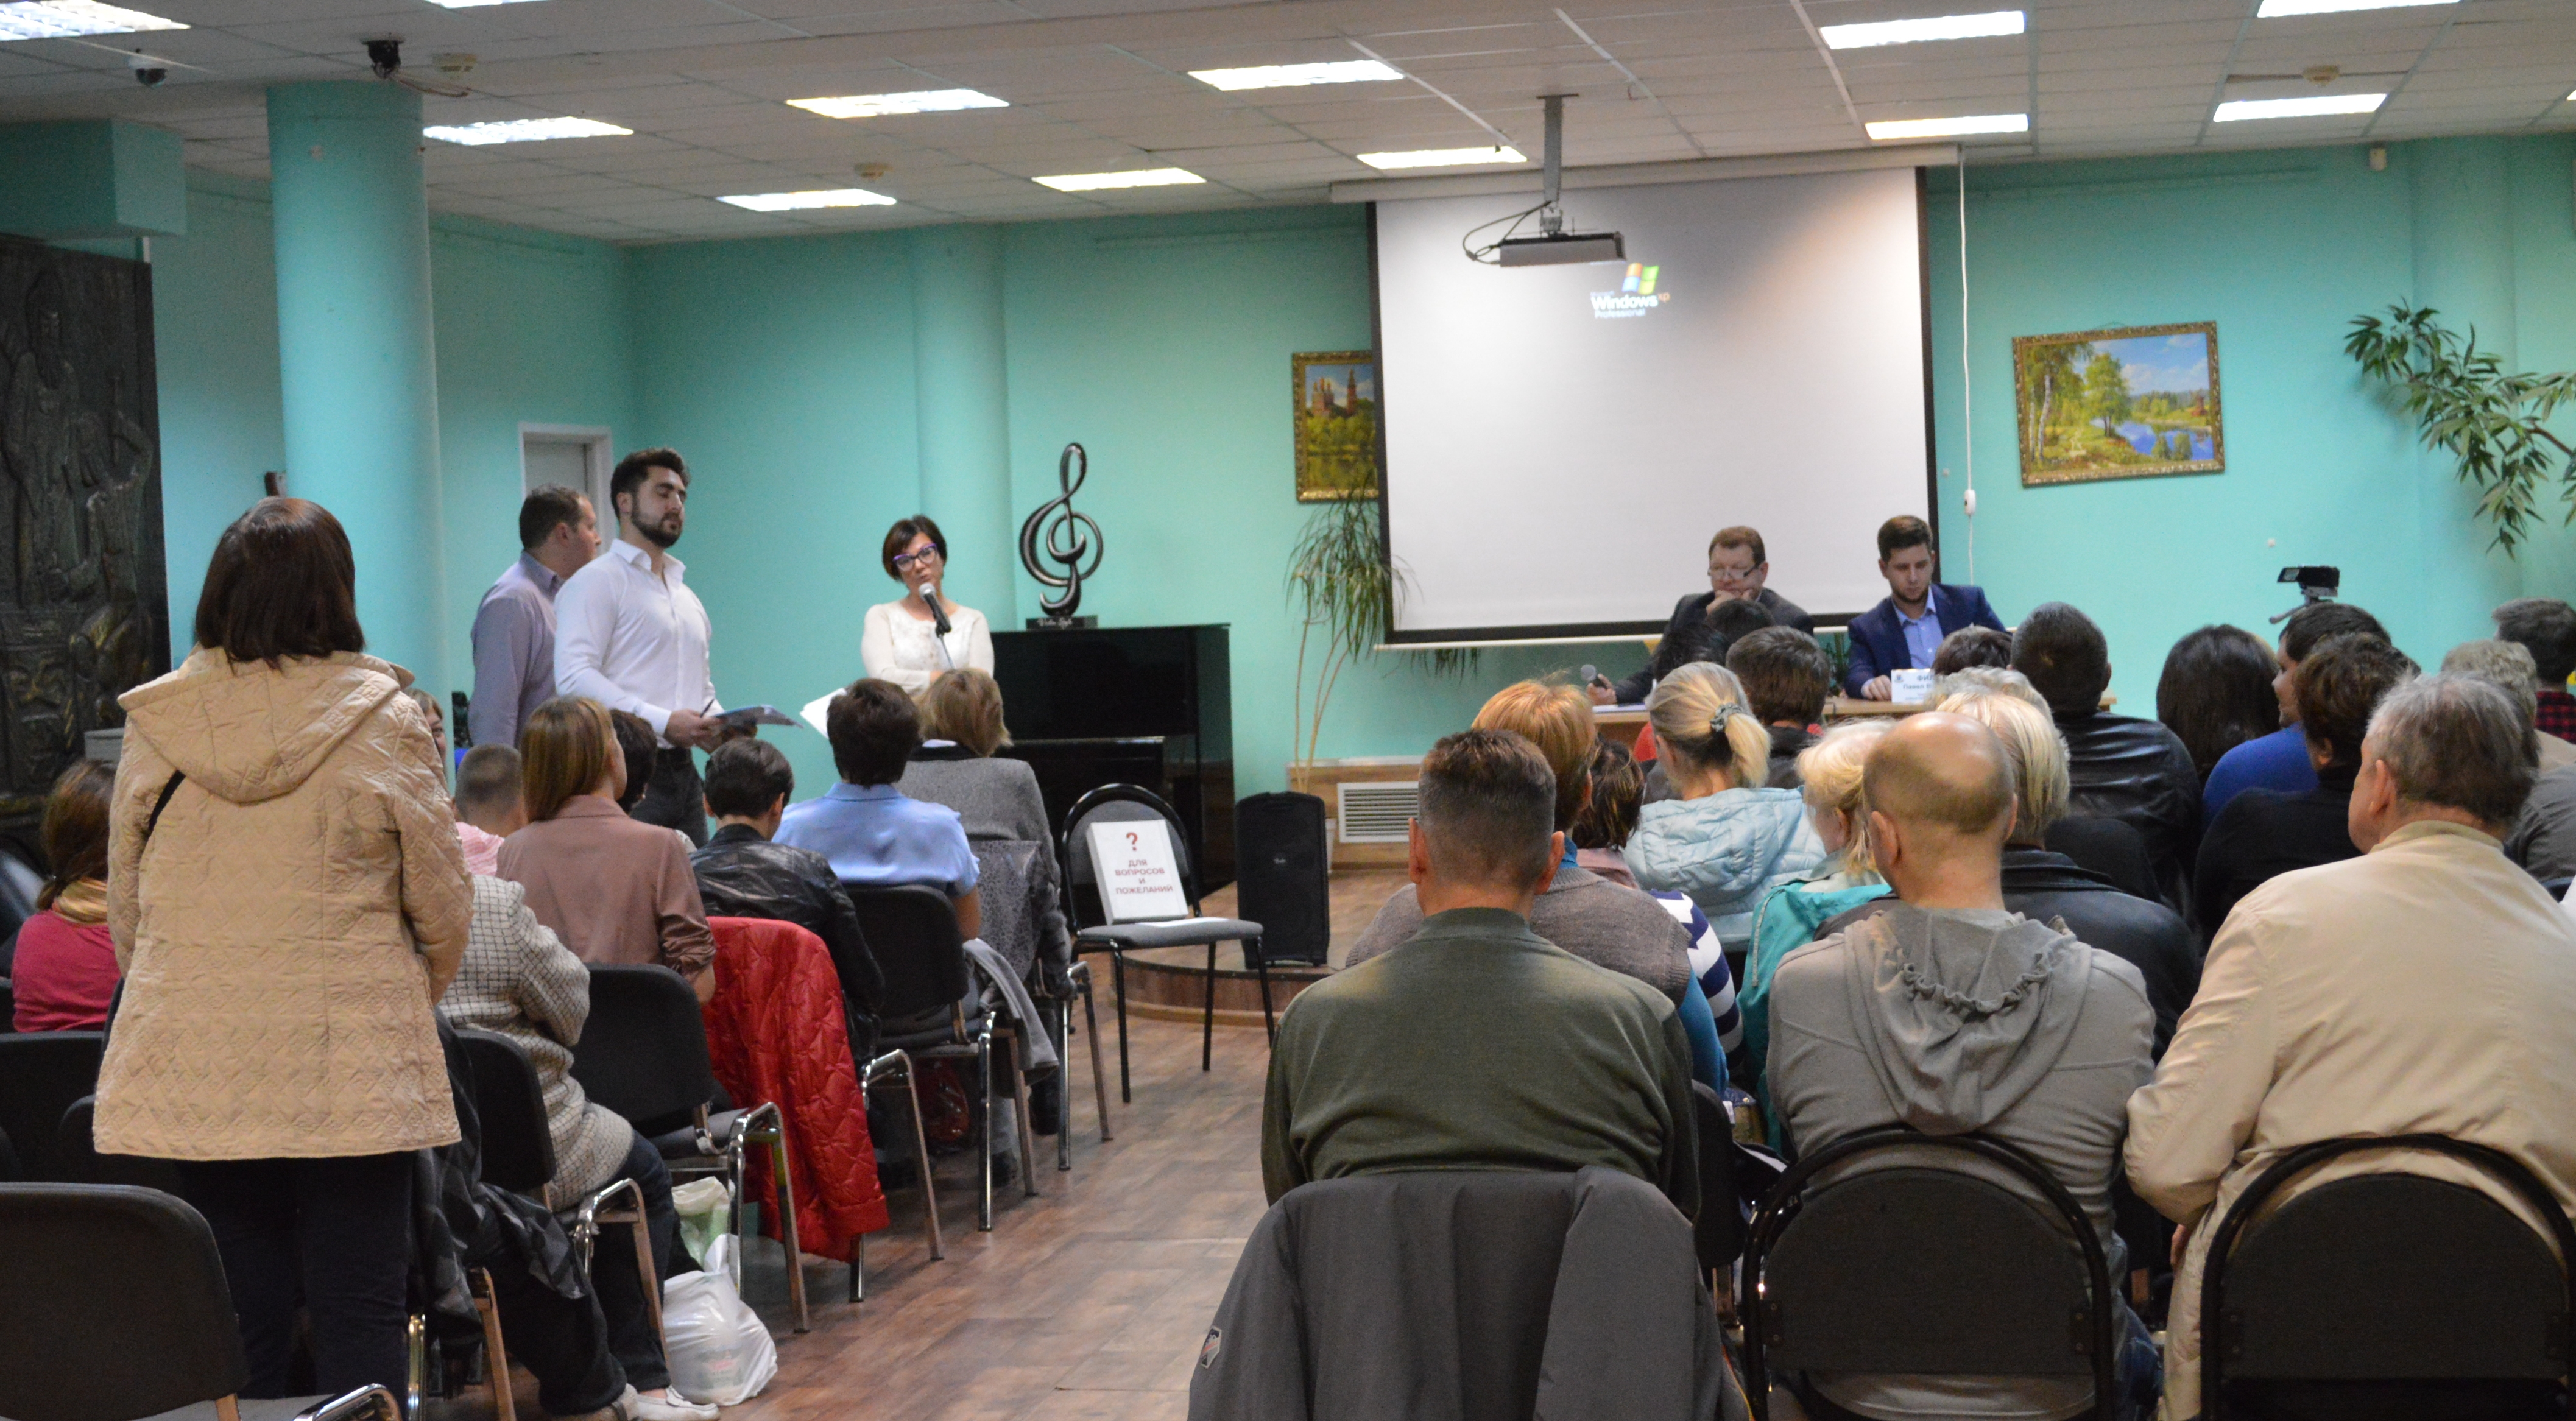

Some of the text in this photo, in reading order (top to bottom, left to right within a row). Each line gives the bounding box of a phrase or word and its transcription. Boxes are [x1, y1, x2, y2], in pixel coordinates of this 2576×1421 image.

[1590, 294, 1659, 310] Windows
[1595, 308, 1646, 319] Professional
[1115, 867, 1165, 876] ВОПРОСОВ
[1115, 885, 1174, 894] ПОЖЕЛАНИЙ
